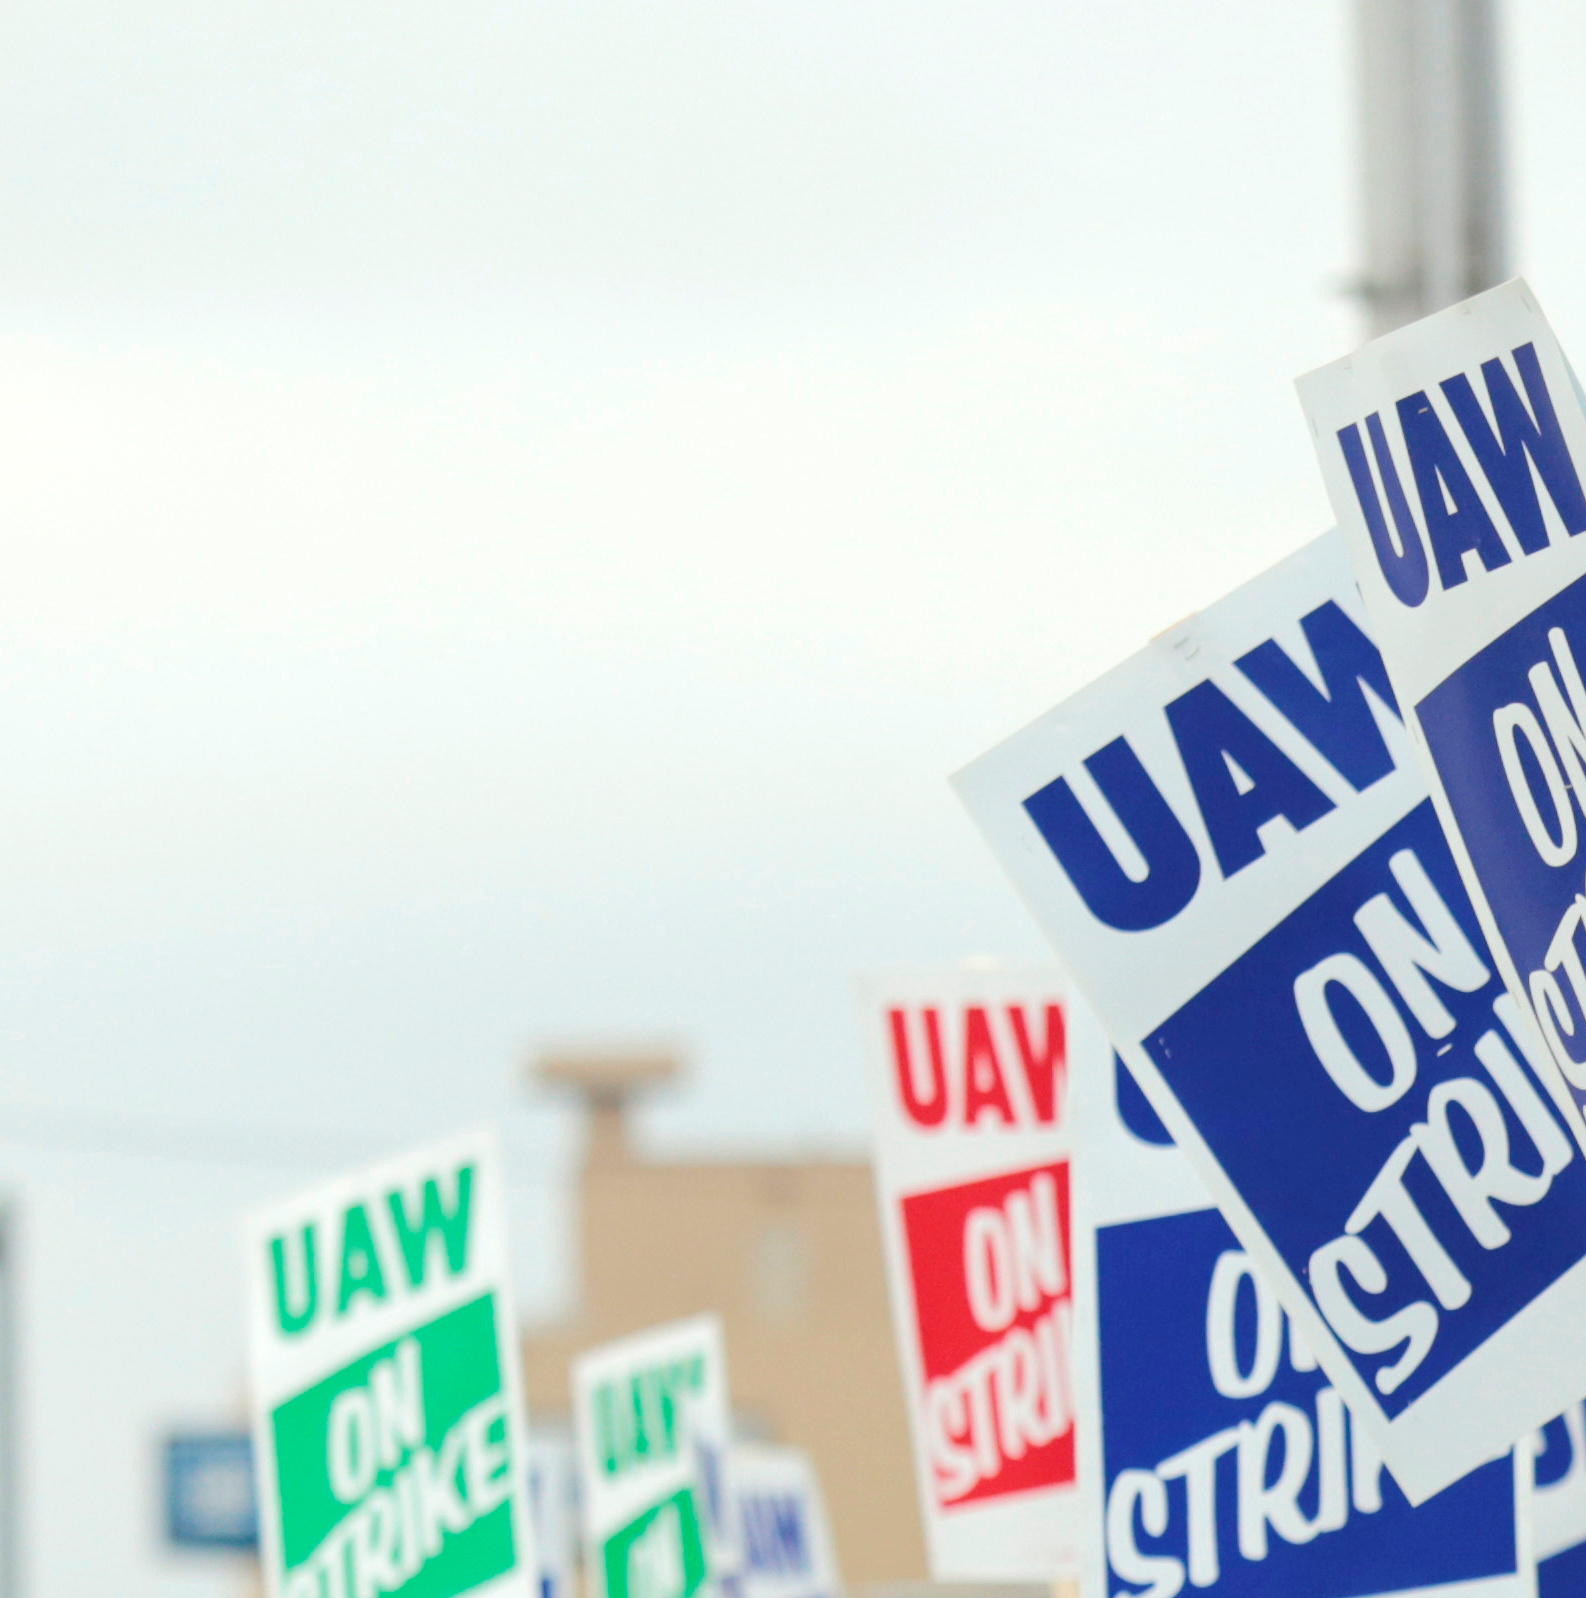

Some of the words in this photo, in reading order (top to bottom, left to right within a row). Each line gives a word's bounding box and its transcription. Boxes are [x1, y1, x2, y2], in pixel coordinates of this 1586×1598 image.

[1293, 848, 1492, 1112] ON
[269, 1162, 476, 1339] UAW
[963, 1171, 1066, 1332] ON
[1308, 992, 1574, 1396] STRI
[326, 1334, 426, 1504] ON
[928, 1300, 1075, 1500] STRI
